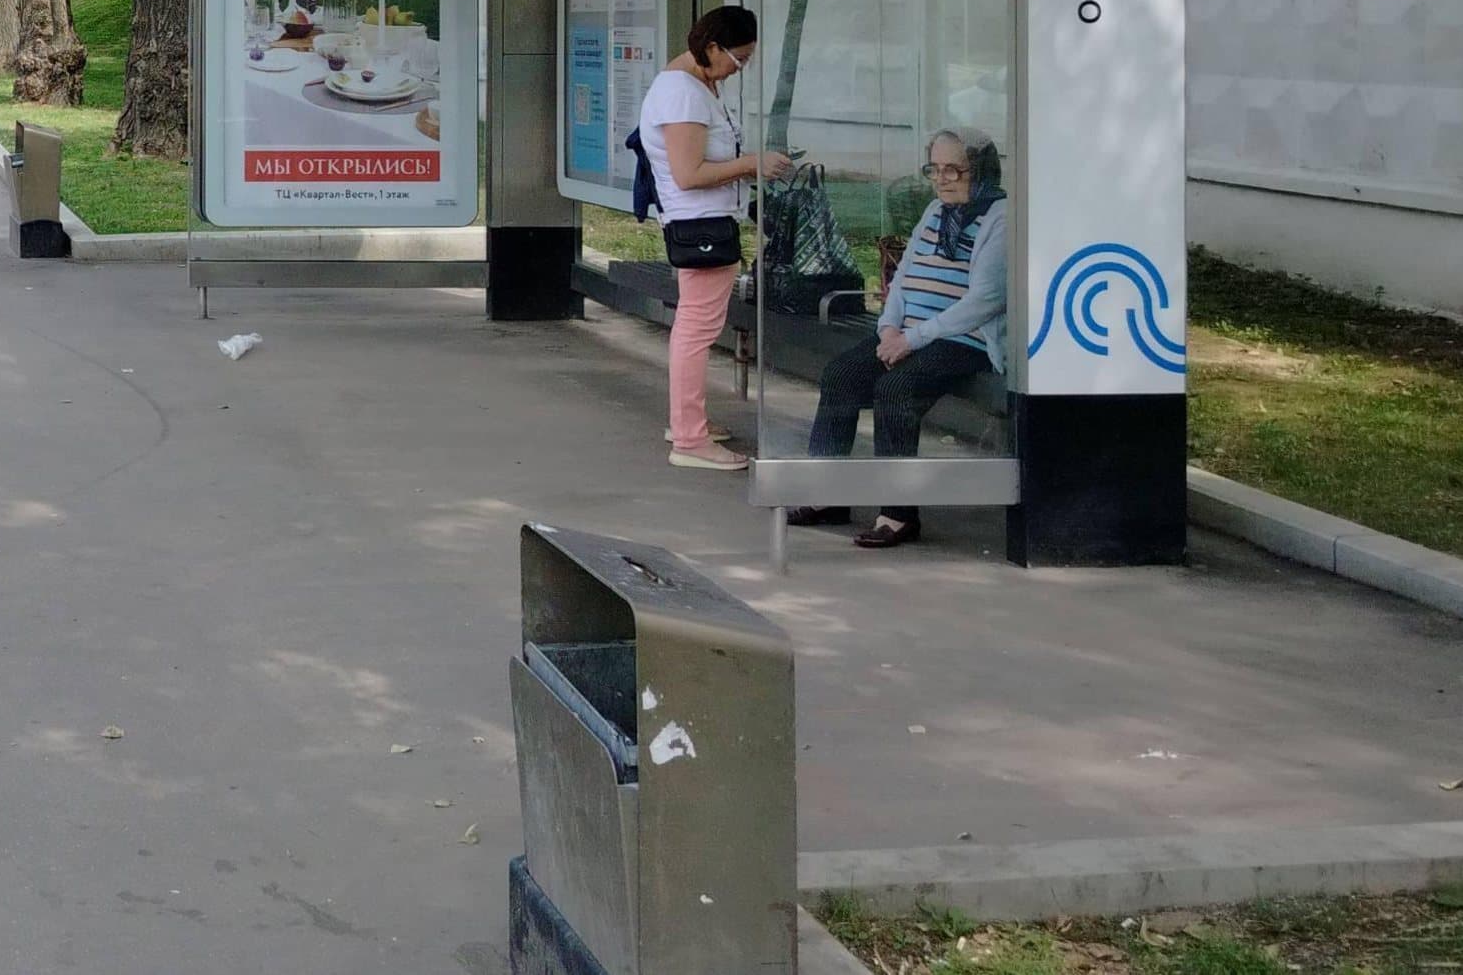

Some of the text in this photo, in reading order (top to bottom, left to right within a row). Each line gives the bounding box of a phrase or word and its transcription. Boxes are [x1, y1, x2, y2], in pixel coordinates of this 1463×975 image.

[255, 158, 431, 175] МЫ ОТКРЫЛИСЬ!
[275, 189, 291, 200] ТЦ
[386, 191, 410, 199] этаж
